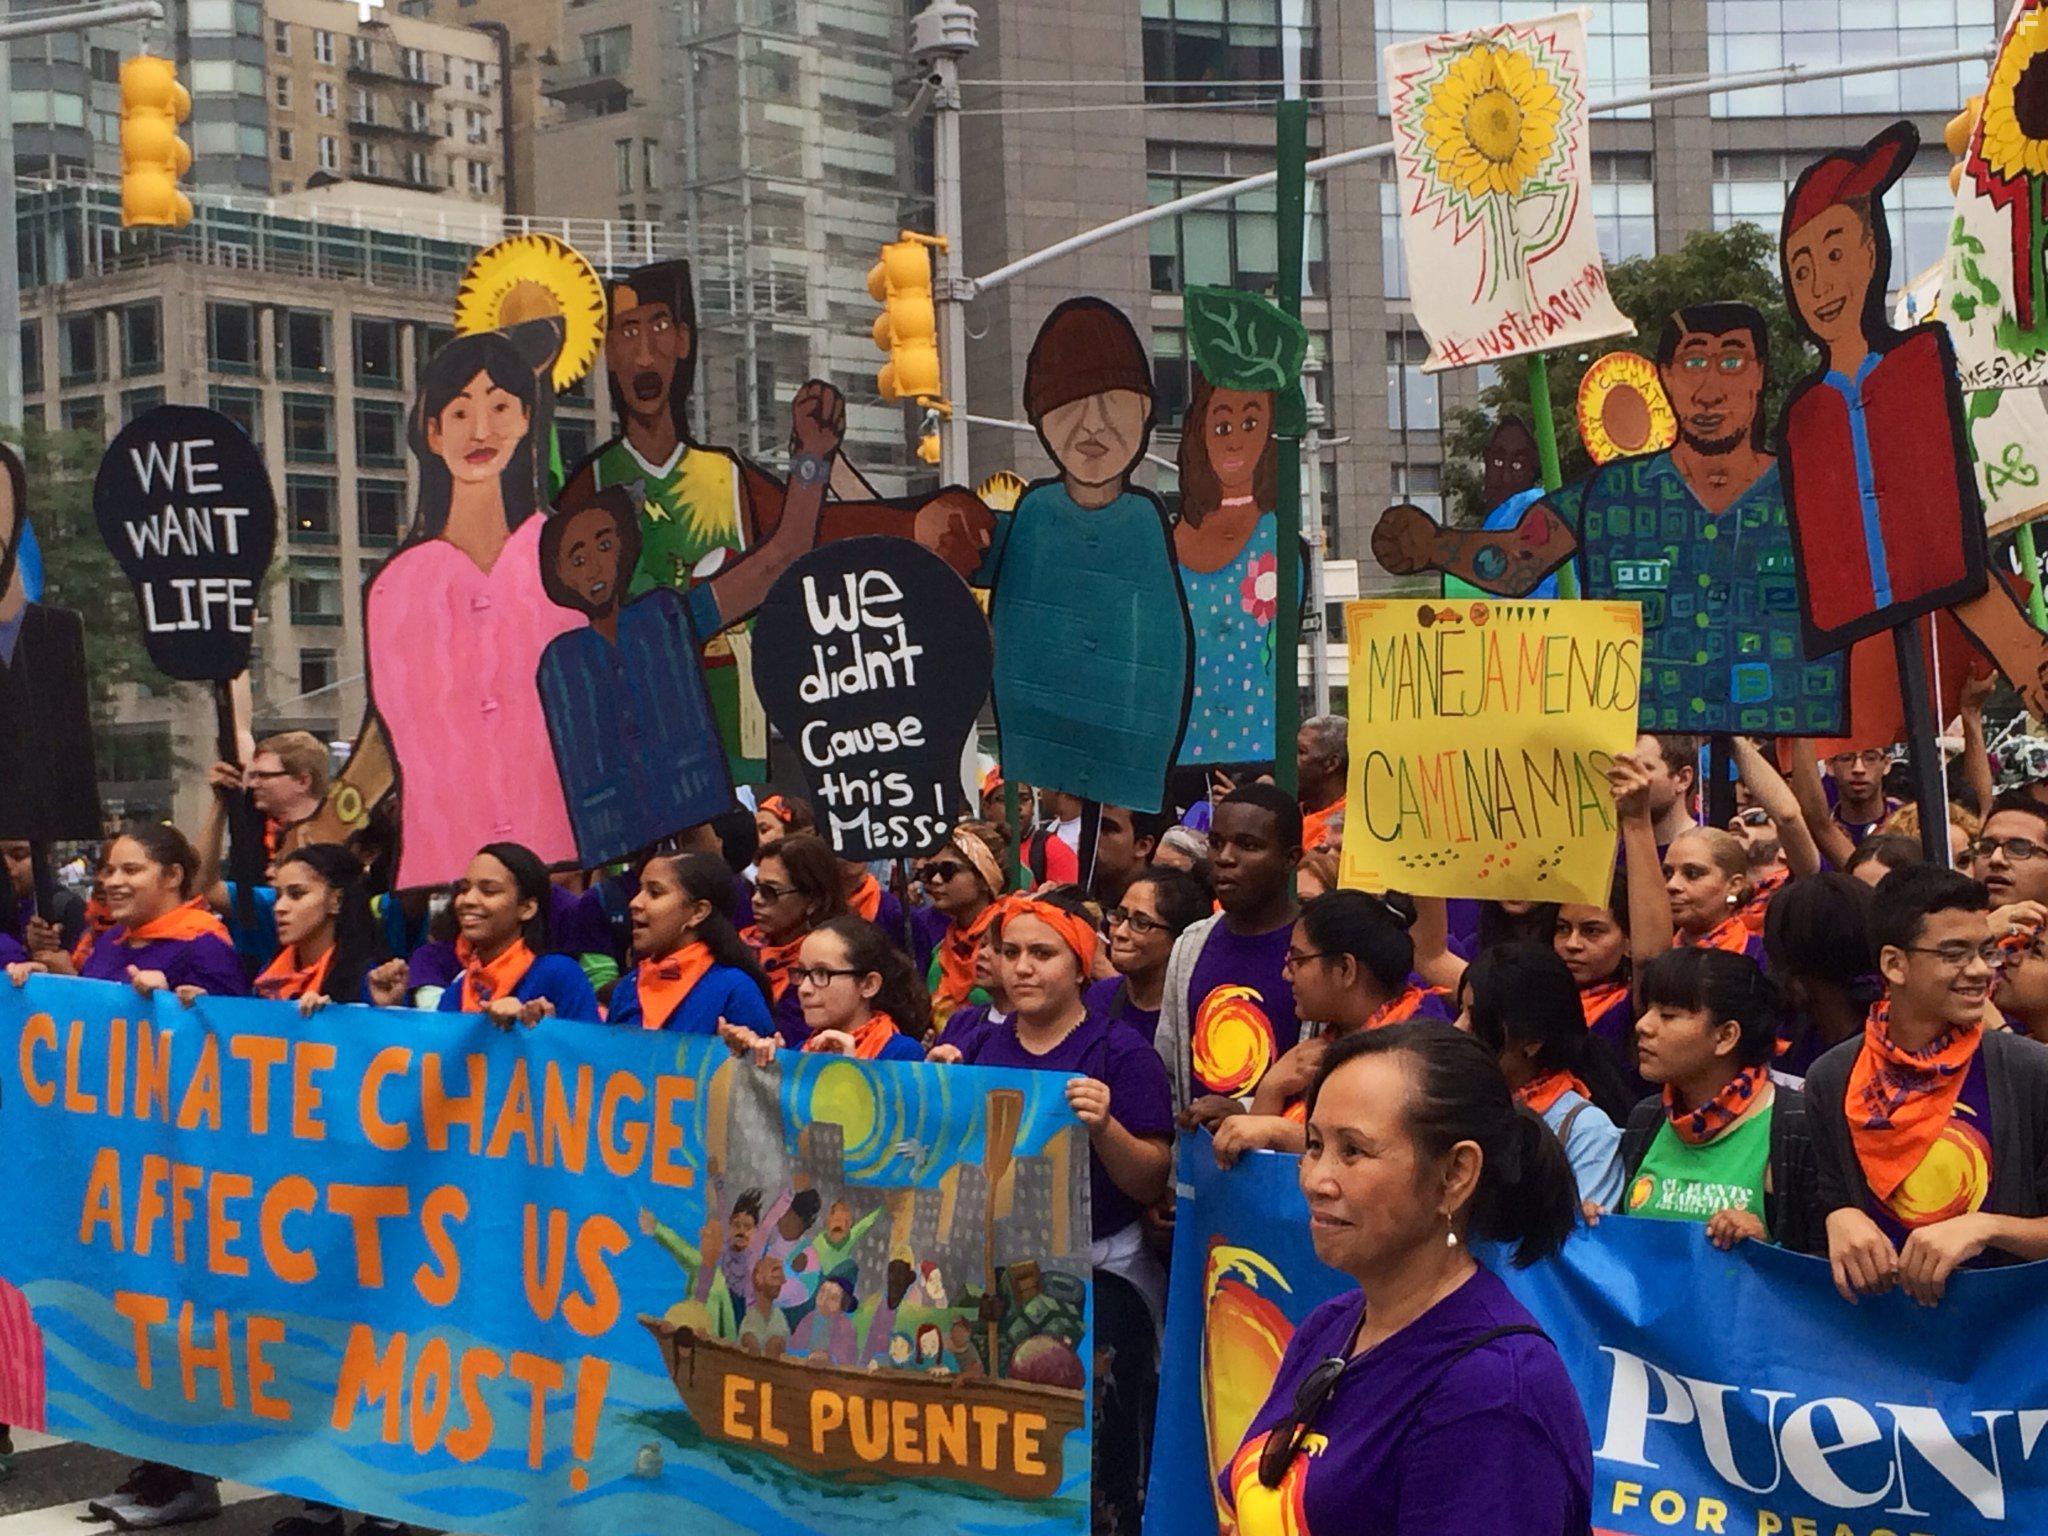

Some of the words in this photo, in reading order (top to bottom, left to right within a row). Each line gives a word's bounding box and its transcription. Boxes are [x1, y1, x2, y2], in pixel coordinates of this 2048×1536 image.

[1599, 361, 1671, 419] CLIMATE
[130, 439, 223, 494] WE
[123, 504, 249, 559] WANT
[142, 578, 253, 632] LIFE
[802, 569, 904, 635] We
[800, 622, 924, 703] didn't
[1368, 629, 1508, 724] MANEJA
[1516, 632, 1639, 714] MENOS
[801, 715, 926, 767] Cause
[817, 768, 915, 807] this
[827, 783, 948, 851] Mess!
[1364, 747, 1526, 842] CAMINA
[19, 1012, 336, 1141] CLIMATE
[358, 1047, 696, 1188] CHANGE
[80, 1149, 469, 1306] AFFECTS
[523, 1203, 631, 1338] US
[114, 1291, 292, 1422] THE
[331, 1324, 610, 1492] MOST!
[722, 1374, 789, 1446] EL
[810, 1388, 1047, 1476] PUENTE
[1611, 1480, 1728, 1534] FOR
